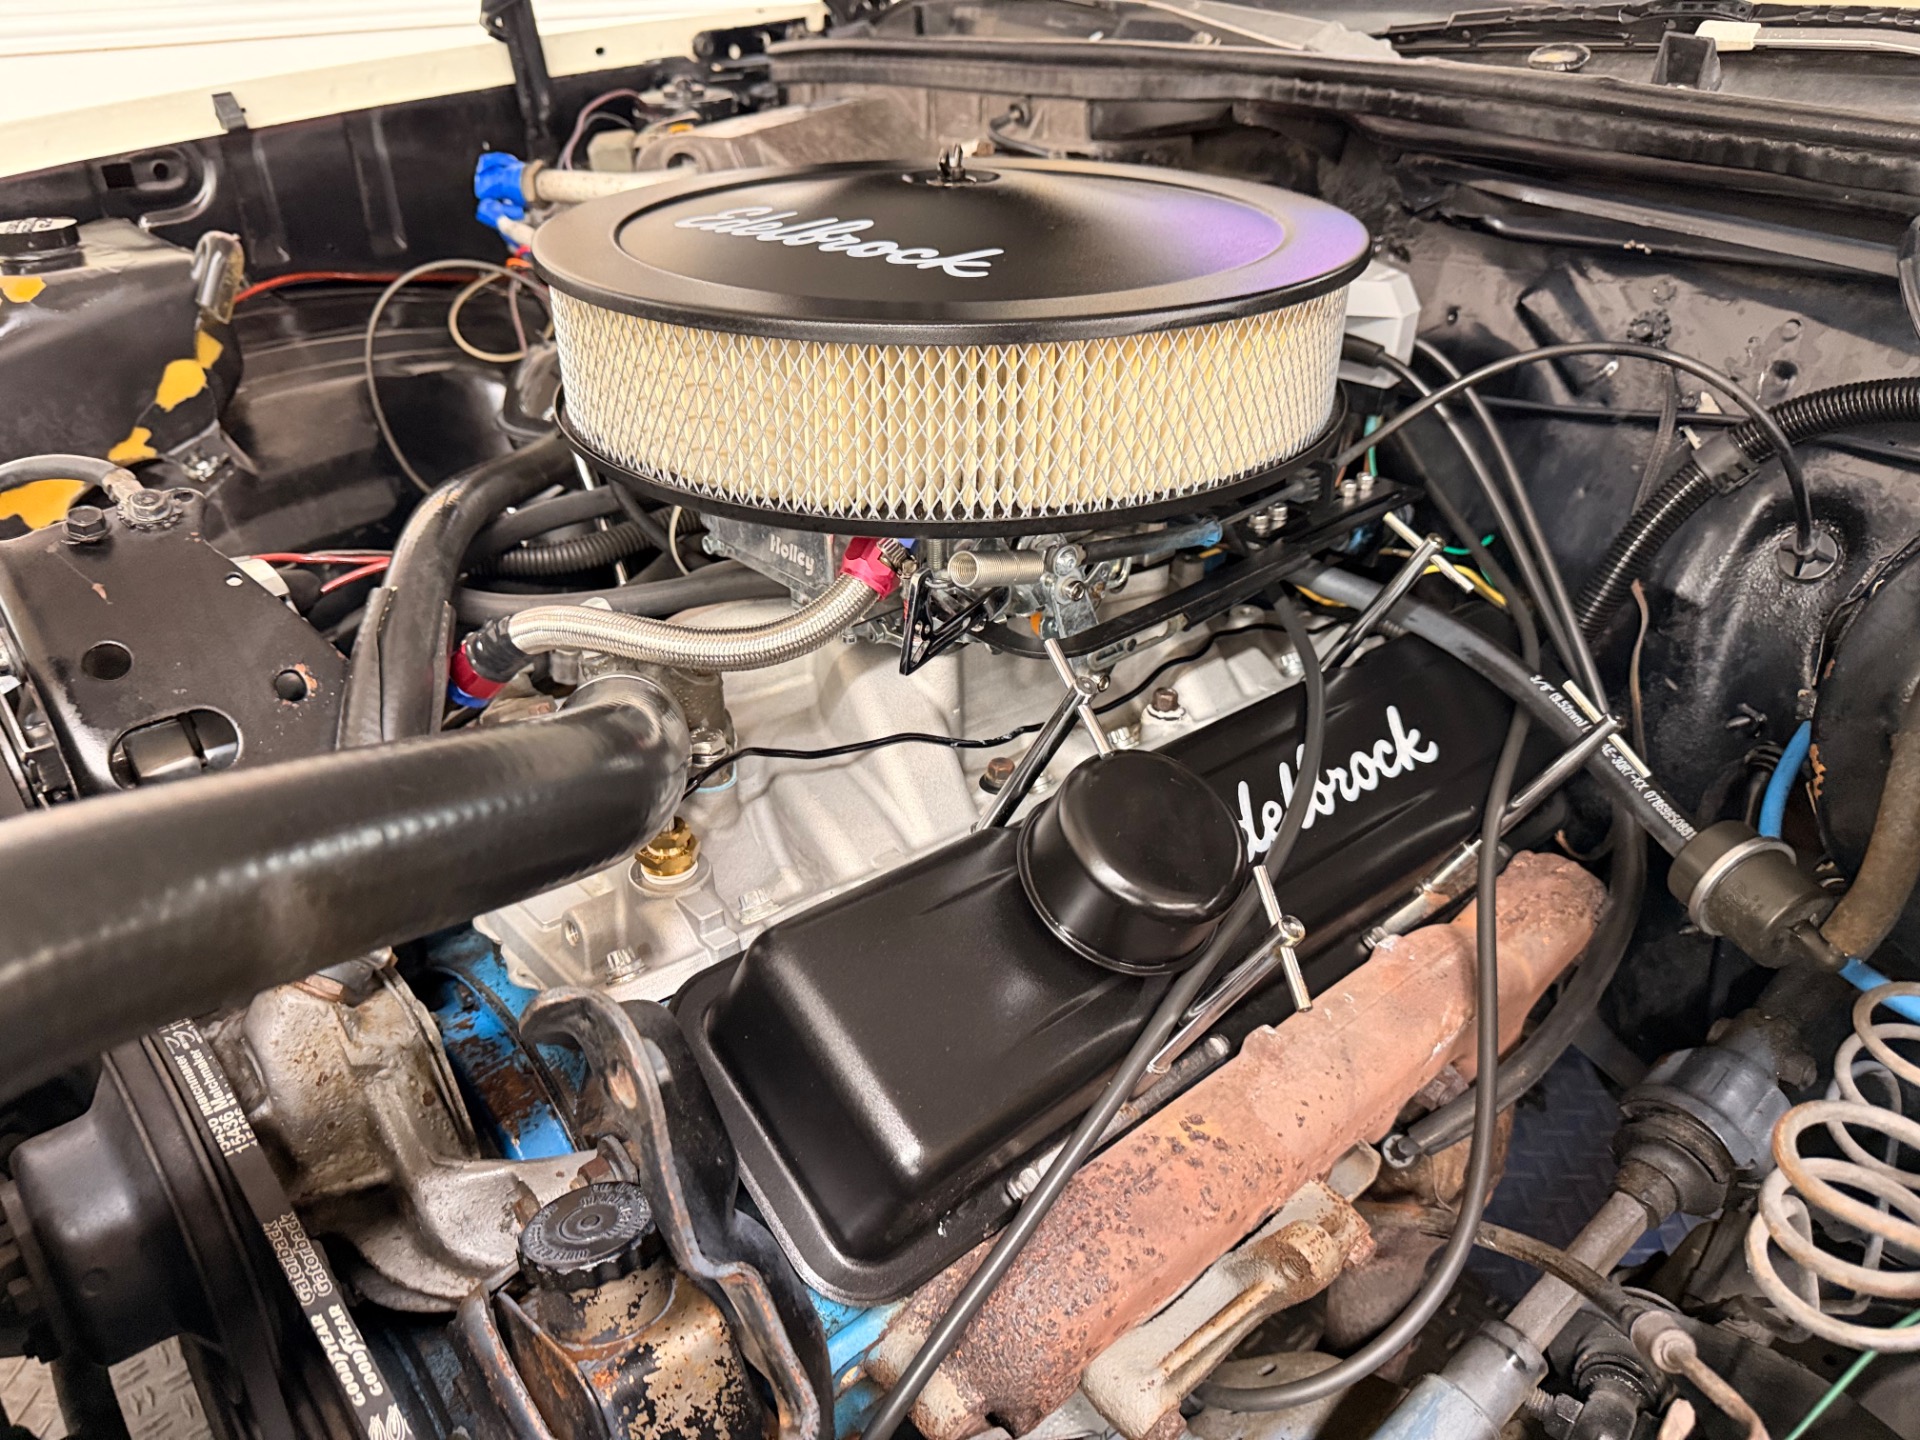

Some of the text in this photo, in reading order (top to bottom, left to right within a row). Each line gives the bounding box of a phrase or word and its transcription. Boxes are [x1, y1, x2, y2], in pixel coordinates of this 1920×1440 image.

[674, 206, 1004, 278] Edelbrock
[769, 533, 815, 576] Holley
[1237, 704, 1440, 863] delbrock
[1601, 743, 1649, 795] AE-30R7-KX
[189, 1048, 230, 1113] Matchmaker
[219, 1110, 250, 1154] 15436
[262, 1219, 366, 1407] GOODYEAR Gatorback
[280, 1210, 384, 1397] GOODYEAR Gatorback
